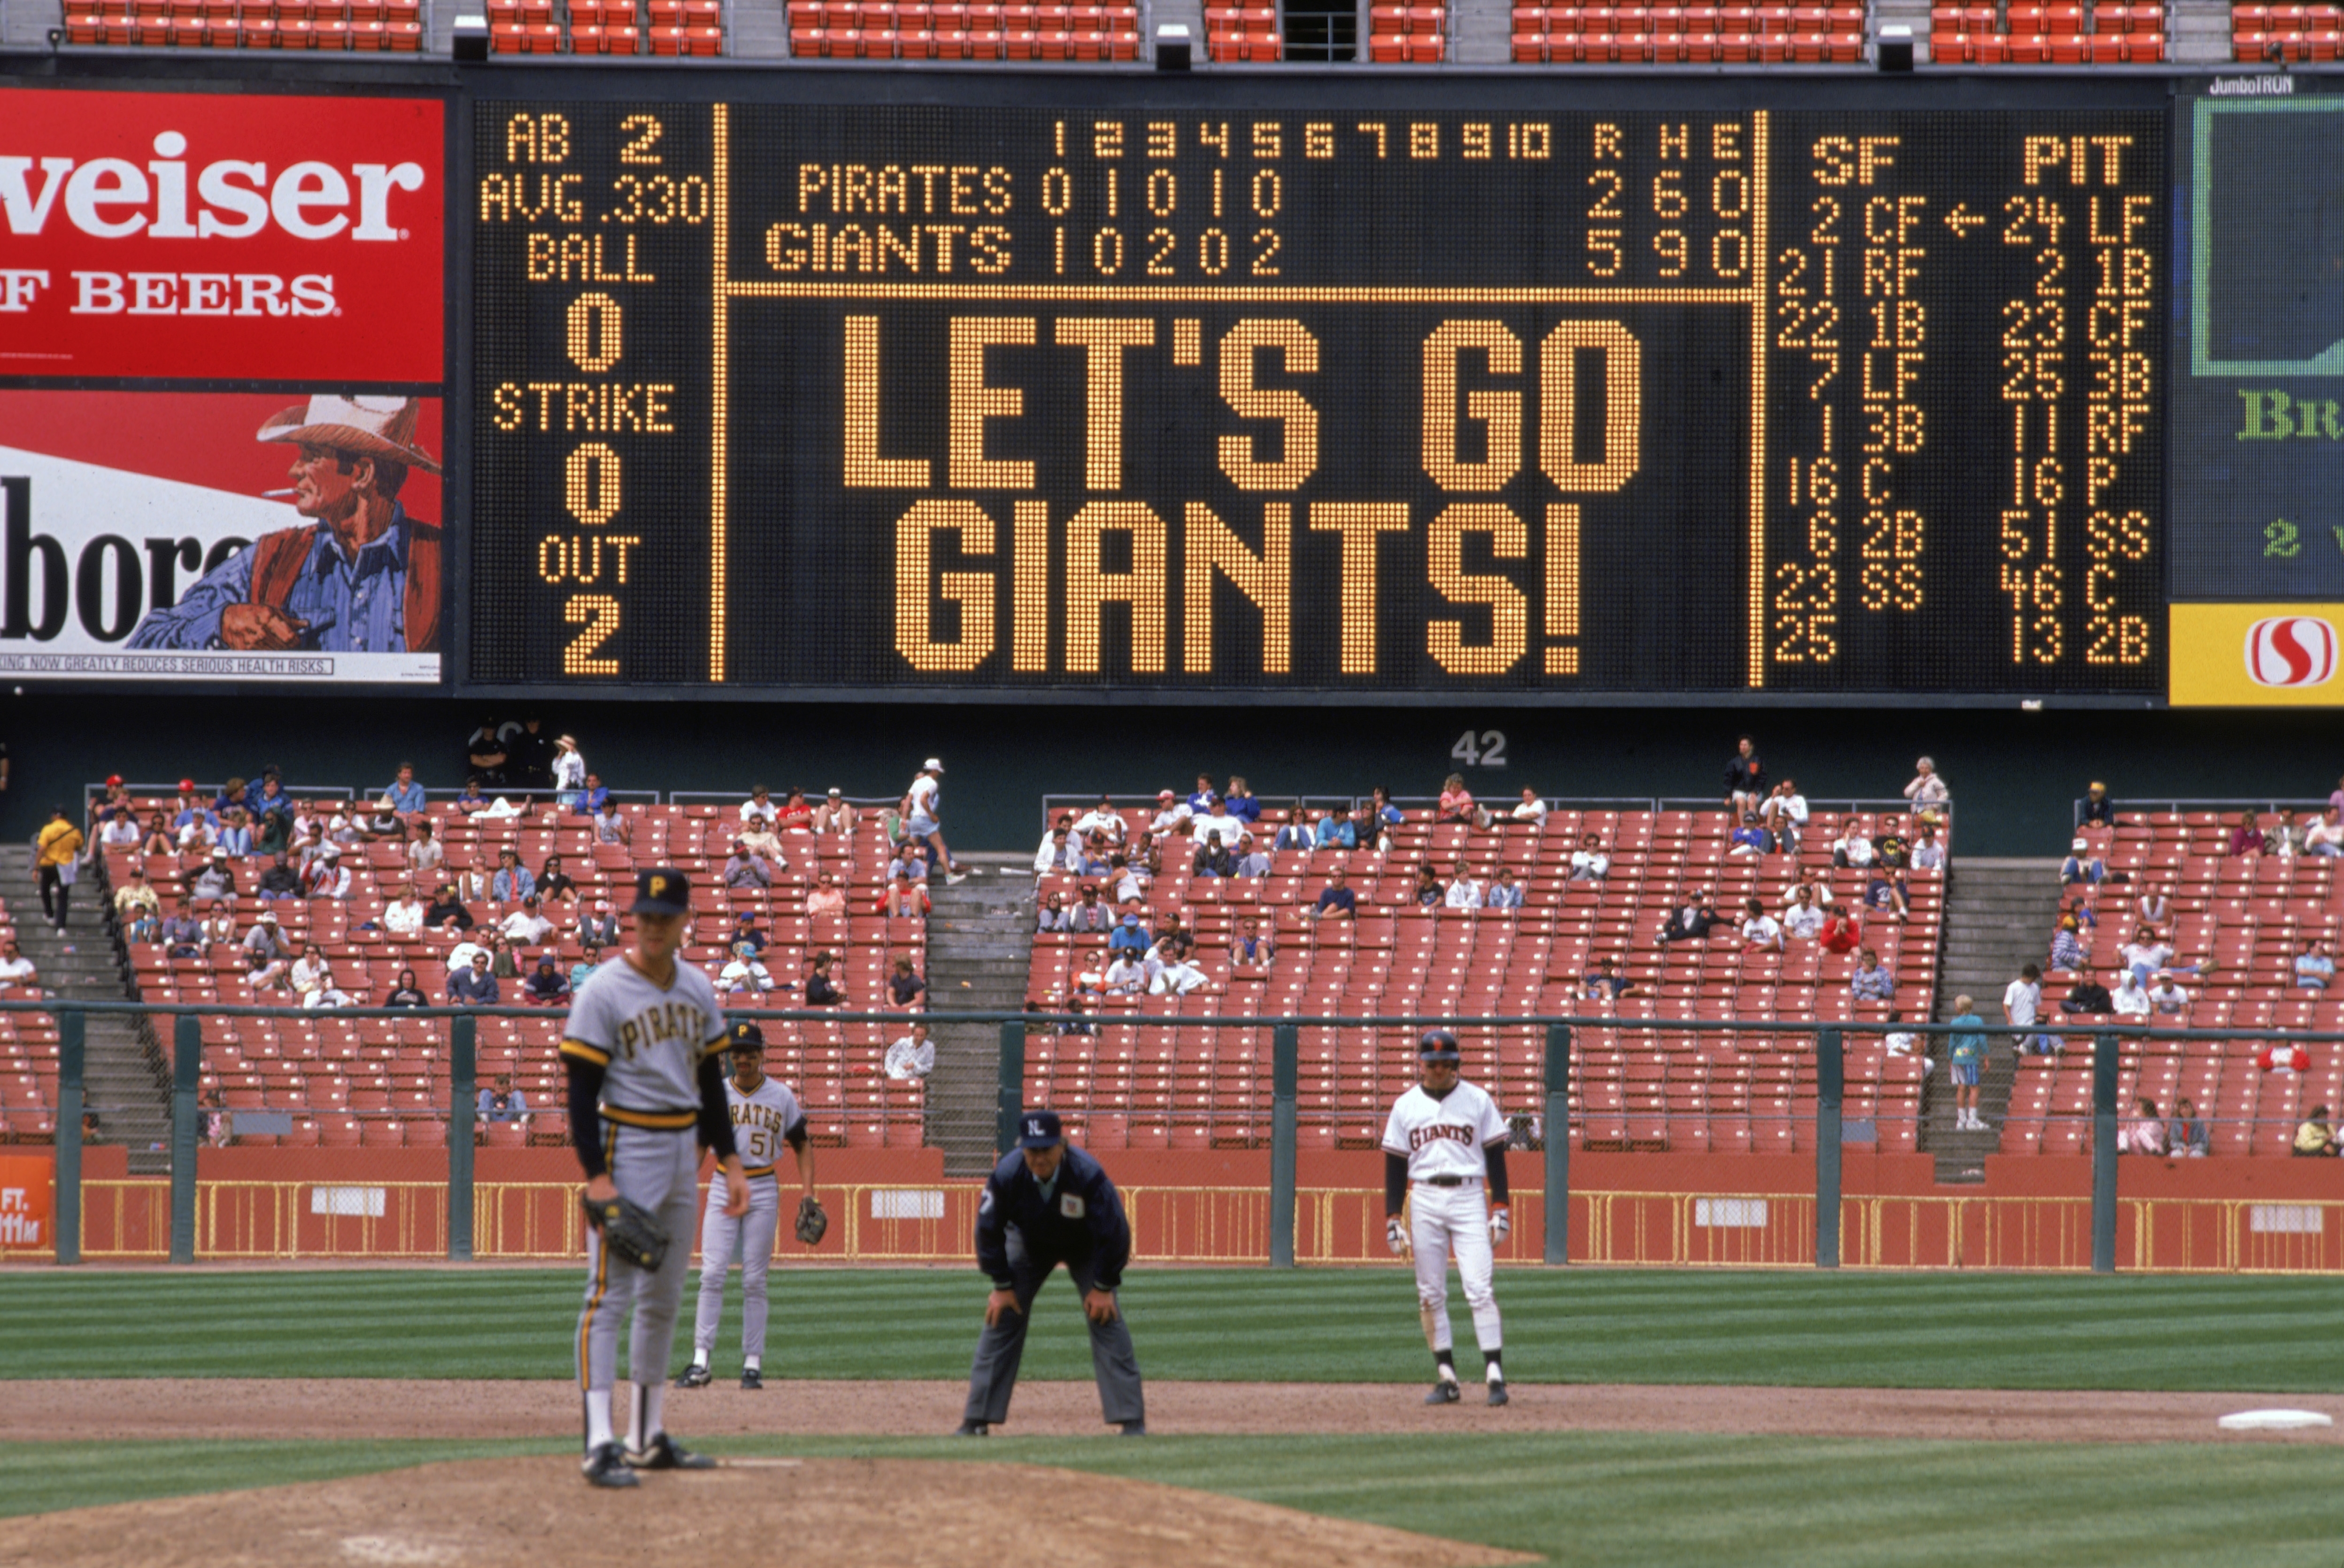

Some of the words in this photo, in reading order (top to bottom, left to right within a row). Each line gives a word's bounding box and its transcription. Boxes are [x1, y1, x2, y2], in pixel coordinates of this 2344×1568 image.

[2210, 75, 2292, 94] JumboTRON
[507, 113, 570, 163] AB
[620, 114, 663, 165] 2
[1055, 120, 1065, 157] 1
[1094, 121, 1124, 159] 2
[1147, 121, 1177, 158] 3
[1200, 122, 1229, 159] 4
[1252, 122, 1282, 159] 5
[1304, 122, 1334, 159] 6
[1357, 122, 1387, 159] 7
[1410, 122, 1439, 159] 8
[1462, 122, 1492, 160] 9
[1508, 123, 1551, 160] 10
[1594, 123, 1623, 160] R
[1659, 123, 1689, 160] H
[1712, 123, 1741, 160] E
[1812, 135, 1900, 186] SF
[2023, 135, 2133, 185] PIT
[480, 172, 583, 223] AVG
[600, 174, 709, 224] .330
[798, 163, 1012, 216] PIRATES
[1041, 166, 1072, 216] 0
[1108, 168, 1118, 217] 1
[1147, 168, 1176, 217] 0
[1213, 168, 1223, 217] 1
[1252, 168, 1281, 218] 0
[1587, 169, 1623, 219] 2
[1652, 170, 1689, 219] 6
[1712, 169, 1749, 219] 0
[1811, 195, 1841, 245] 2
[1864, 195, 1927, 245] CF
[2003, 195, 2066, 245] 24
[2089, 195, 2152, 245] LF
[527, 232, 655, 283] BALL
[765, 222, 1012, 274] GIANTS
[1055, 226, 1064, 275] 1
[1094, 226, 1124, 276] 0
[1146, 227, 1176, 276] 2
[1199, 227, 1229, 276] 0
[1251, 227, 1281, 276] 2
[1587, 228, 1622, 277] 5
[1652, 229, 1688, 278] 9
[1712, 228, 1749, 278] 0
[1777, 247, 1834, 297] 21
[1863, 247, 1926, 297] RF
[2036, 248, 2065, 297] 2
[2095, 247, 2152, 297] 1B
[0, 269, 49, 312] F
[70, 271, 335, 317] BEERS
[566, 292, 623, 373] 0
[1777, 300, 1840, 349] 22
[1870, 300, 1926, 348] 1B
[2002, 300, 2065, 349] 23
[2088, 299, 2151, 348] CF
[1810, 352, 1839, 400] 7
[1862, 351, 1925, 401] LF
[2001, 351, 2064, 401] 25
[2088, 351, 2151, 401] 3B
[493, 381, 675, 433] STRIKE
[843, 315, 1319, 491] LET'S
[1421, 318, 1642, 493] GO
[1822, 404, 1832, 453] 1
[1862, 404, 1924, 453] 3B
[2014, 404, 2057, 453] 11
[2087, 403, 2151, 454] RF
[565, 442, 622, 525] 0
[1789, 456, 1838, 506] 16
[1862, 456, 1891, 506] C
[2014, 456, 2063, 507] 16
[2087, 456, 2117, 507] P
[0, 476, 261, 642] bor
[539, 534, 641, 584] OUT
[1808, 510, 1838, 559] 6
[1861, 510, 1924, 559] 2B
[2000, 510, 2056, 560] 51
[2086, 510, 2150, 560] SS
[2263, 518, 2300, 557] 2
[894, 498, 1581, 675] GIANTS!
[1774, 562, 1837, 610] 23
[1860, 563, 1923, 611] SS
[2000, 563, 2062, 611] 46
[2086, 563, 2116, 612] C
[563, 594, 620, 675] 2
[1774, 614, 1837, 663] 25
[2012, 615, 2062, 664] 13
[2086, 615, 2149, 664] 2B
[0, 656, 25, 670] ING
[30, 657, 59, 670] NOW
[64, 657, 118, 672] GREATLY
[122, 658, 177, 672] REDUCES
[181, 658, 233, 672] SERIOUS
[237, 659, 282, 672] HEALTH
[287, 659, 327, 673] RISKS.
[1451, 730, 1506, 766] 42
[649, 876, 666, 898] P
[739, 1024, 748, 1038] P
[750, 1132, 774, 1158] 51
[1410, 1123, 1474, 1151] GIANTS
[1, 1188, 29, 1211] FT.
